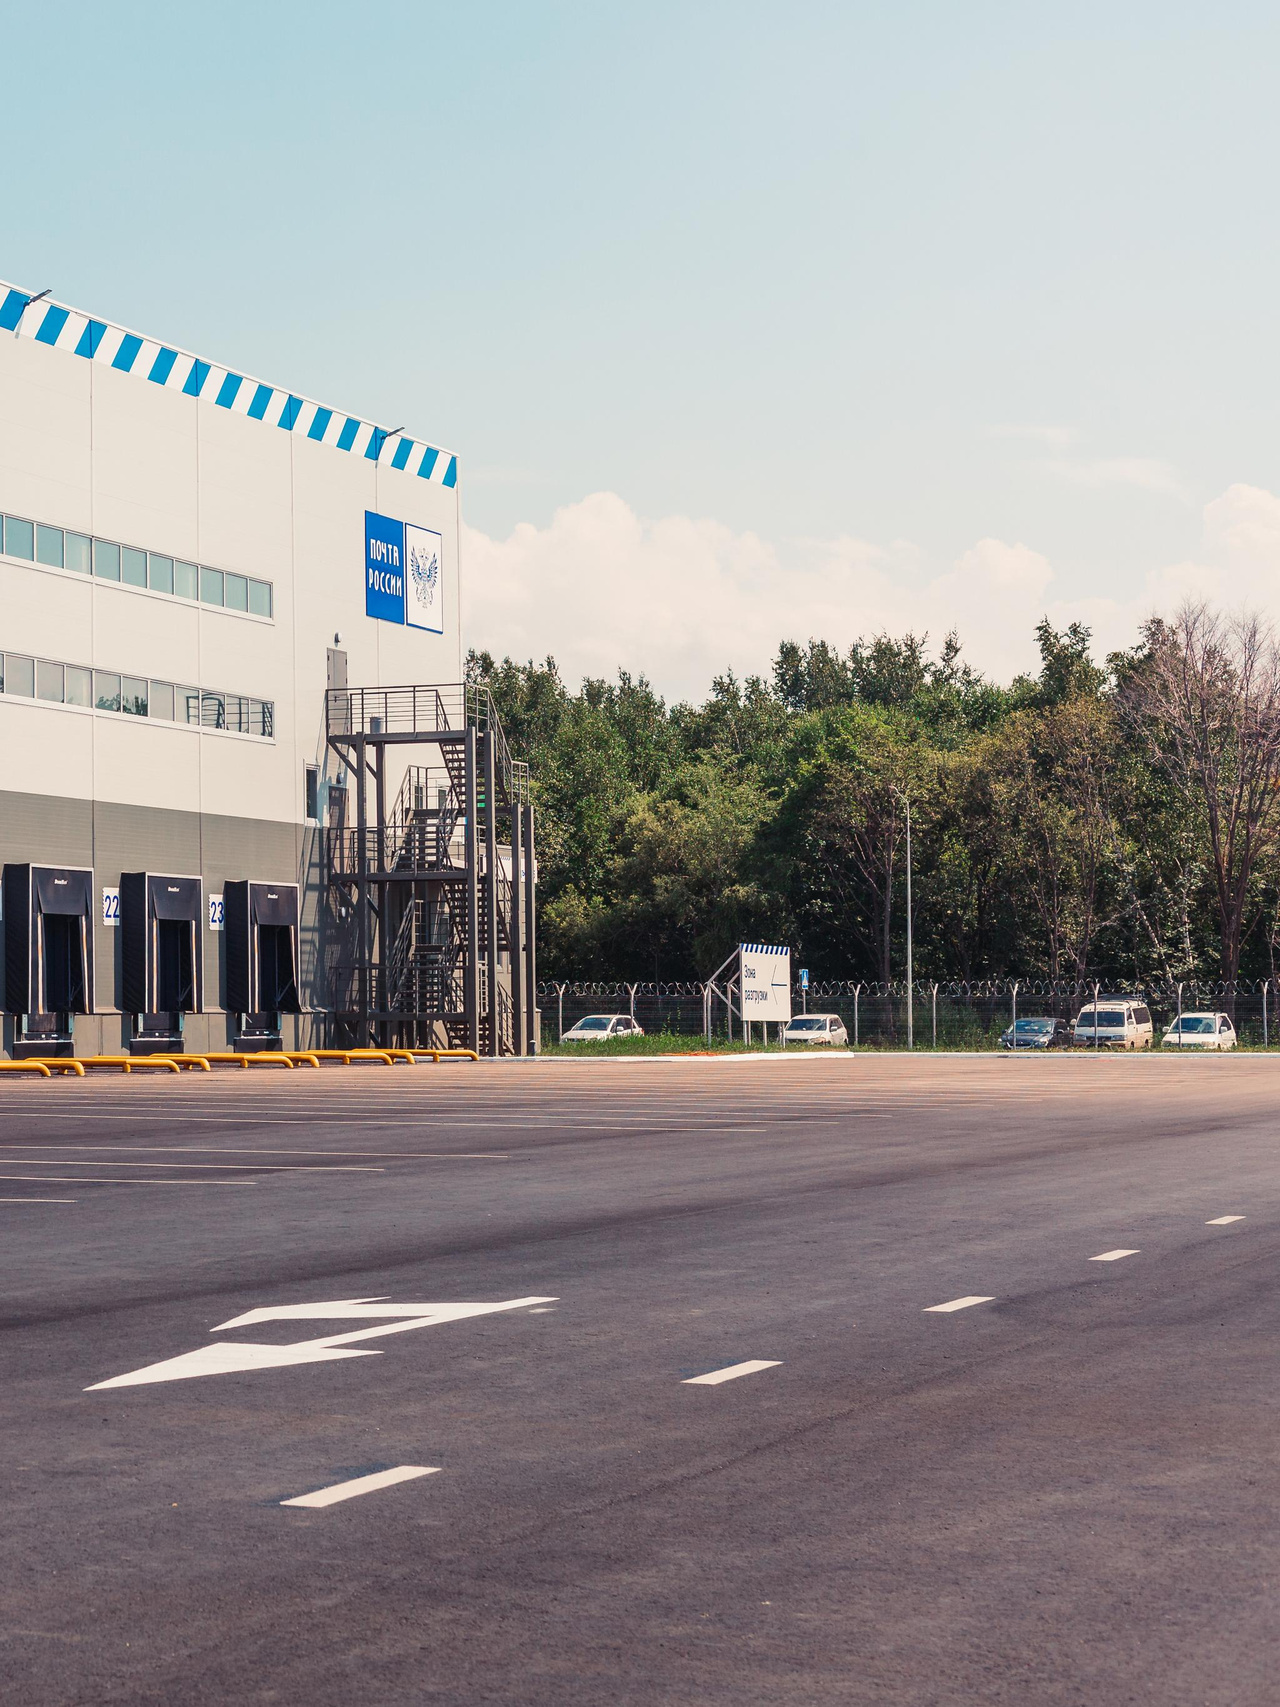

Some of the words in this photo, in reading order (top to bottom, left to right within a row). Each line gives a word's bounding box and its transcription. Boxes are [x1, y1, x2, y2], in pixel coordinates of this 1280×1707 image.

[370, 538, 399, 567] ПОЧТА
[368, 567, 402, 597] РОССИИ
[104, 895, 120, 919] 22
[210, 901, 224, 924] 23
[744, 964, 756, 979] Зона
